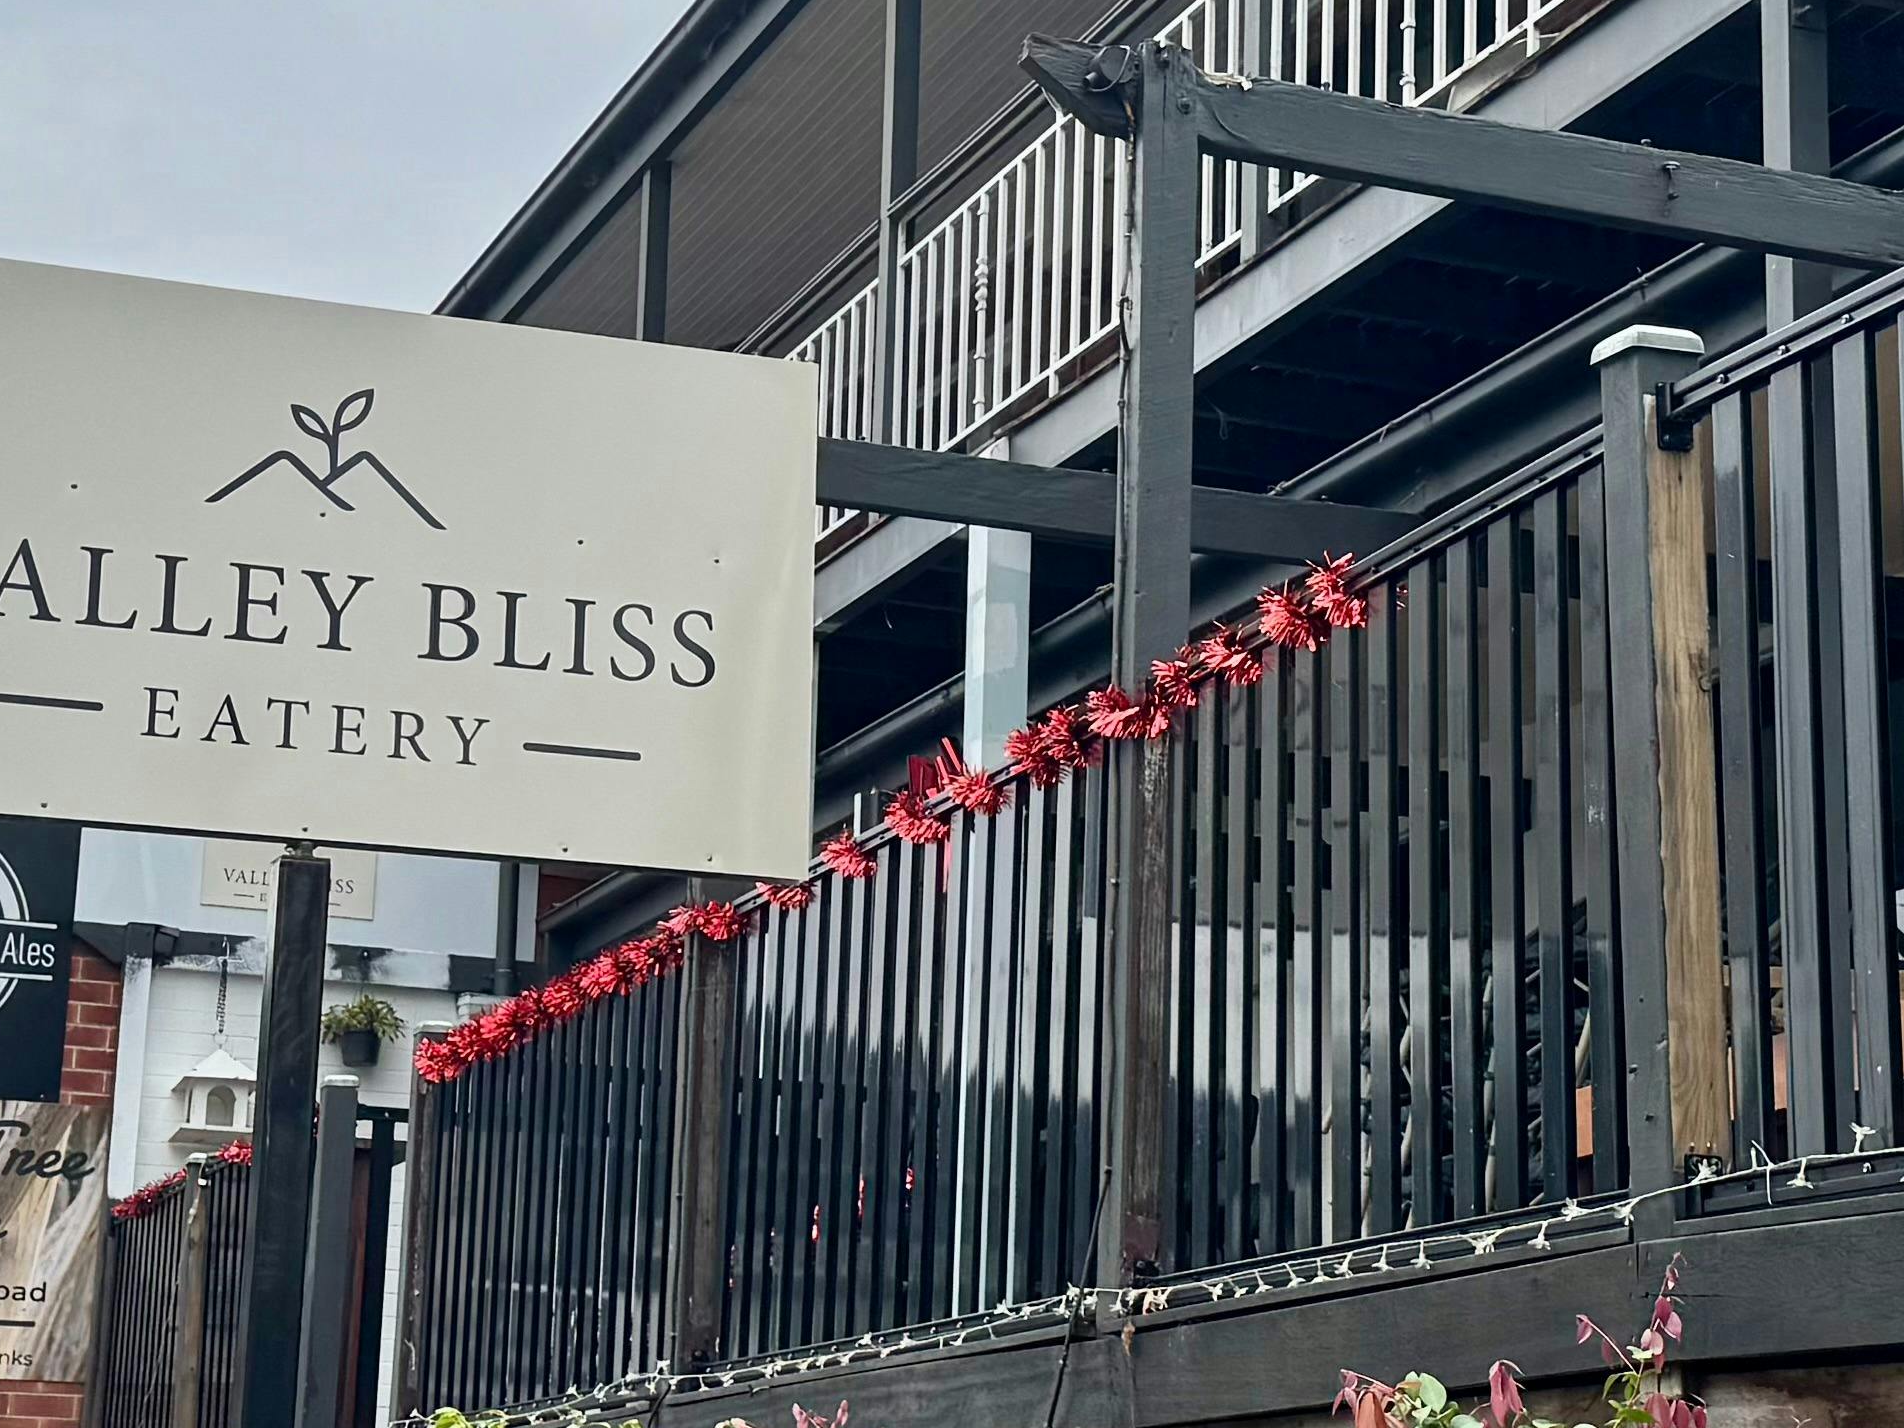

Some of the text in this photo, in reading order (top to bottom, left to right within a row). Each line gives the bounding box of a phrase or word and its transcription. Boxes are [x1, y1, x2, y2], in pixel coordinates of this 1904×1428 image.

[417, 581, 717, 688] BLISS
[139, 685, 492, 767] EATERY
[223, 867, 270, 886] VALL
[0, 931, 56, 968] Ales
